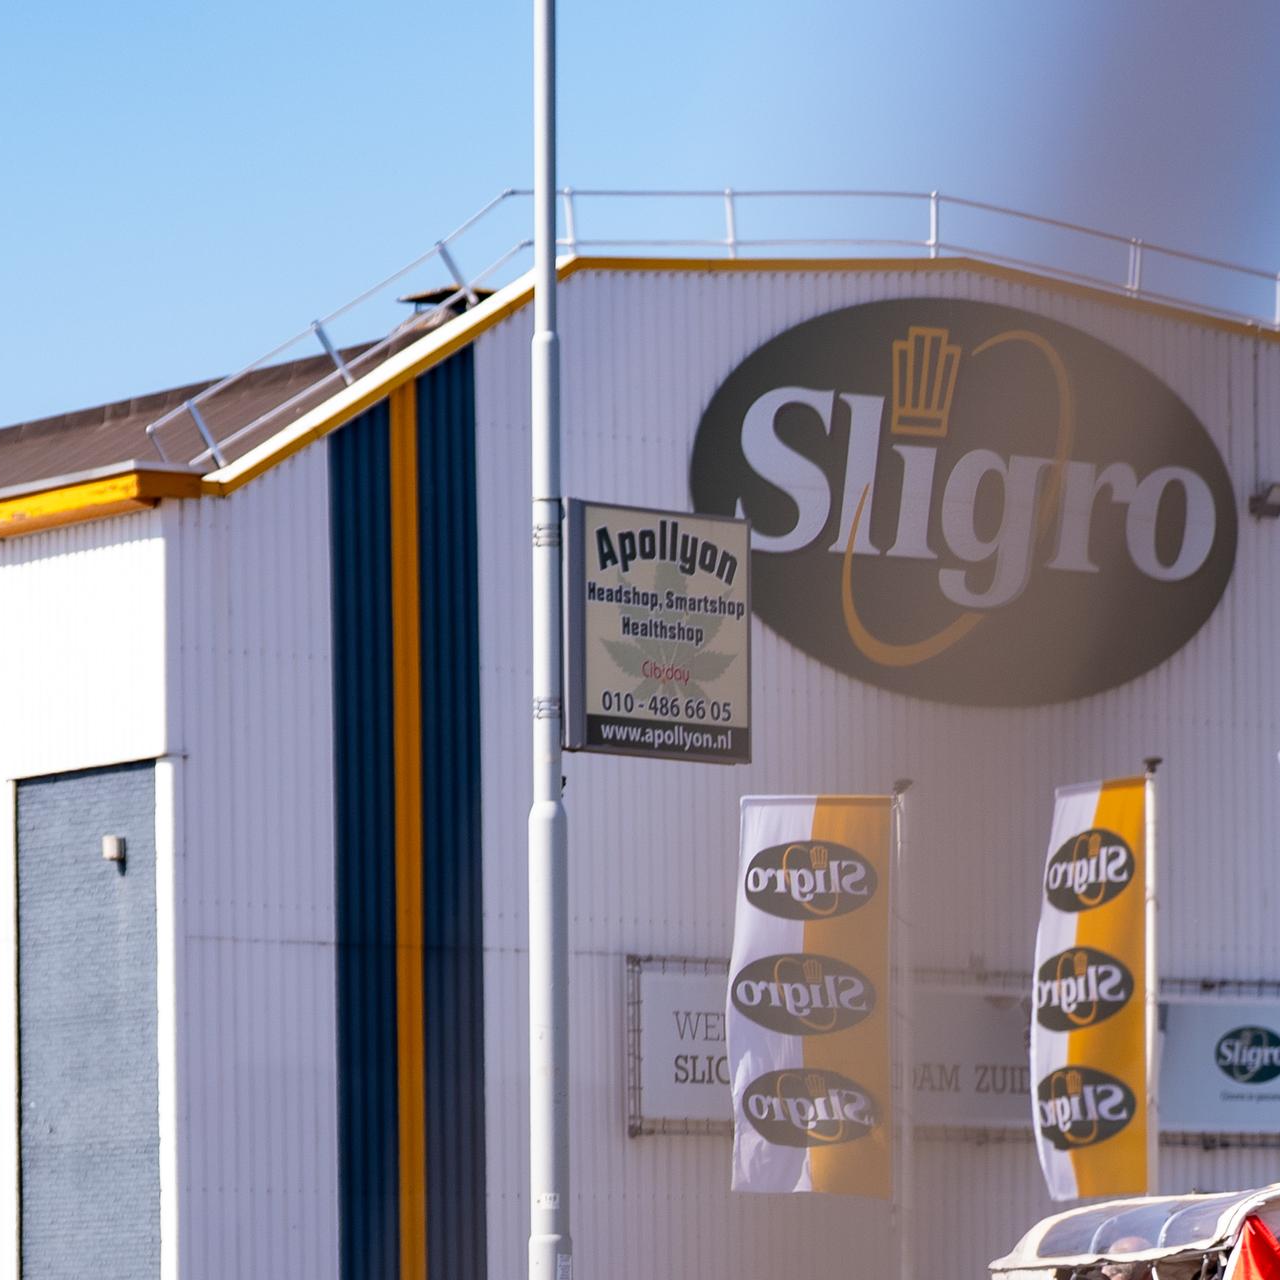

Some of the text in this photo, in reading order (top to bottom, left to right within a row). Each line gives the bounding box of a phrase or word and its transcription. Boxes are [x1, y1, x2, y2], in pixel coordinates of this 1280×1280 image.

[735, 385, 1217, 608] Sligro
[595, 520, 738, 586] Apollyon
[588, 581, 745, 621] Headshop, Smartshop
[621, 616, 704, 647] Healthshop
[602, 691, 634, 713] 010
[648, 695, 680, 718] 486
[685, 699, 706, 720] 66
[711, 701, 732, 722] 05
[601, 723, 732, 751] www.apollyon.nl
